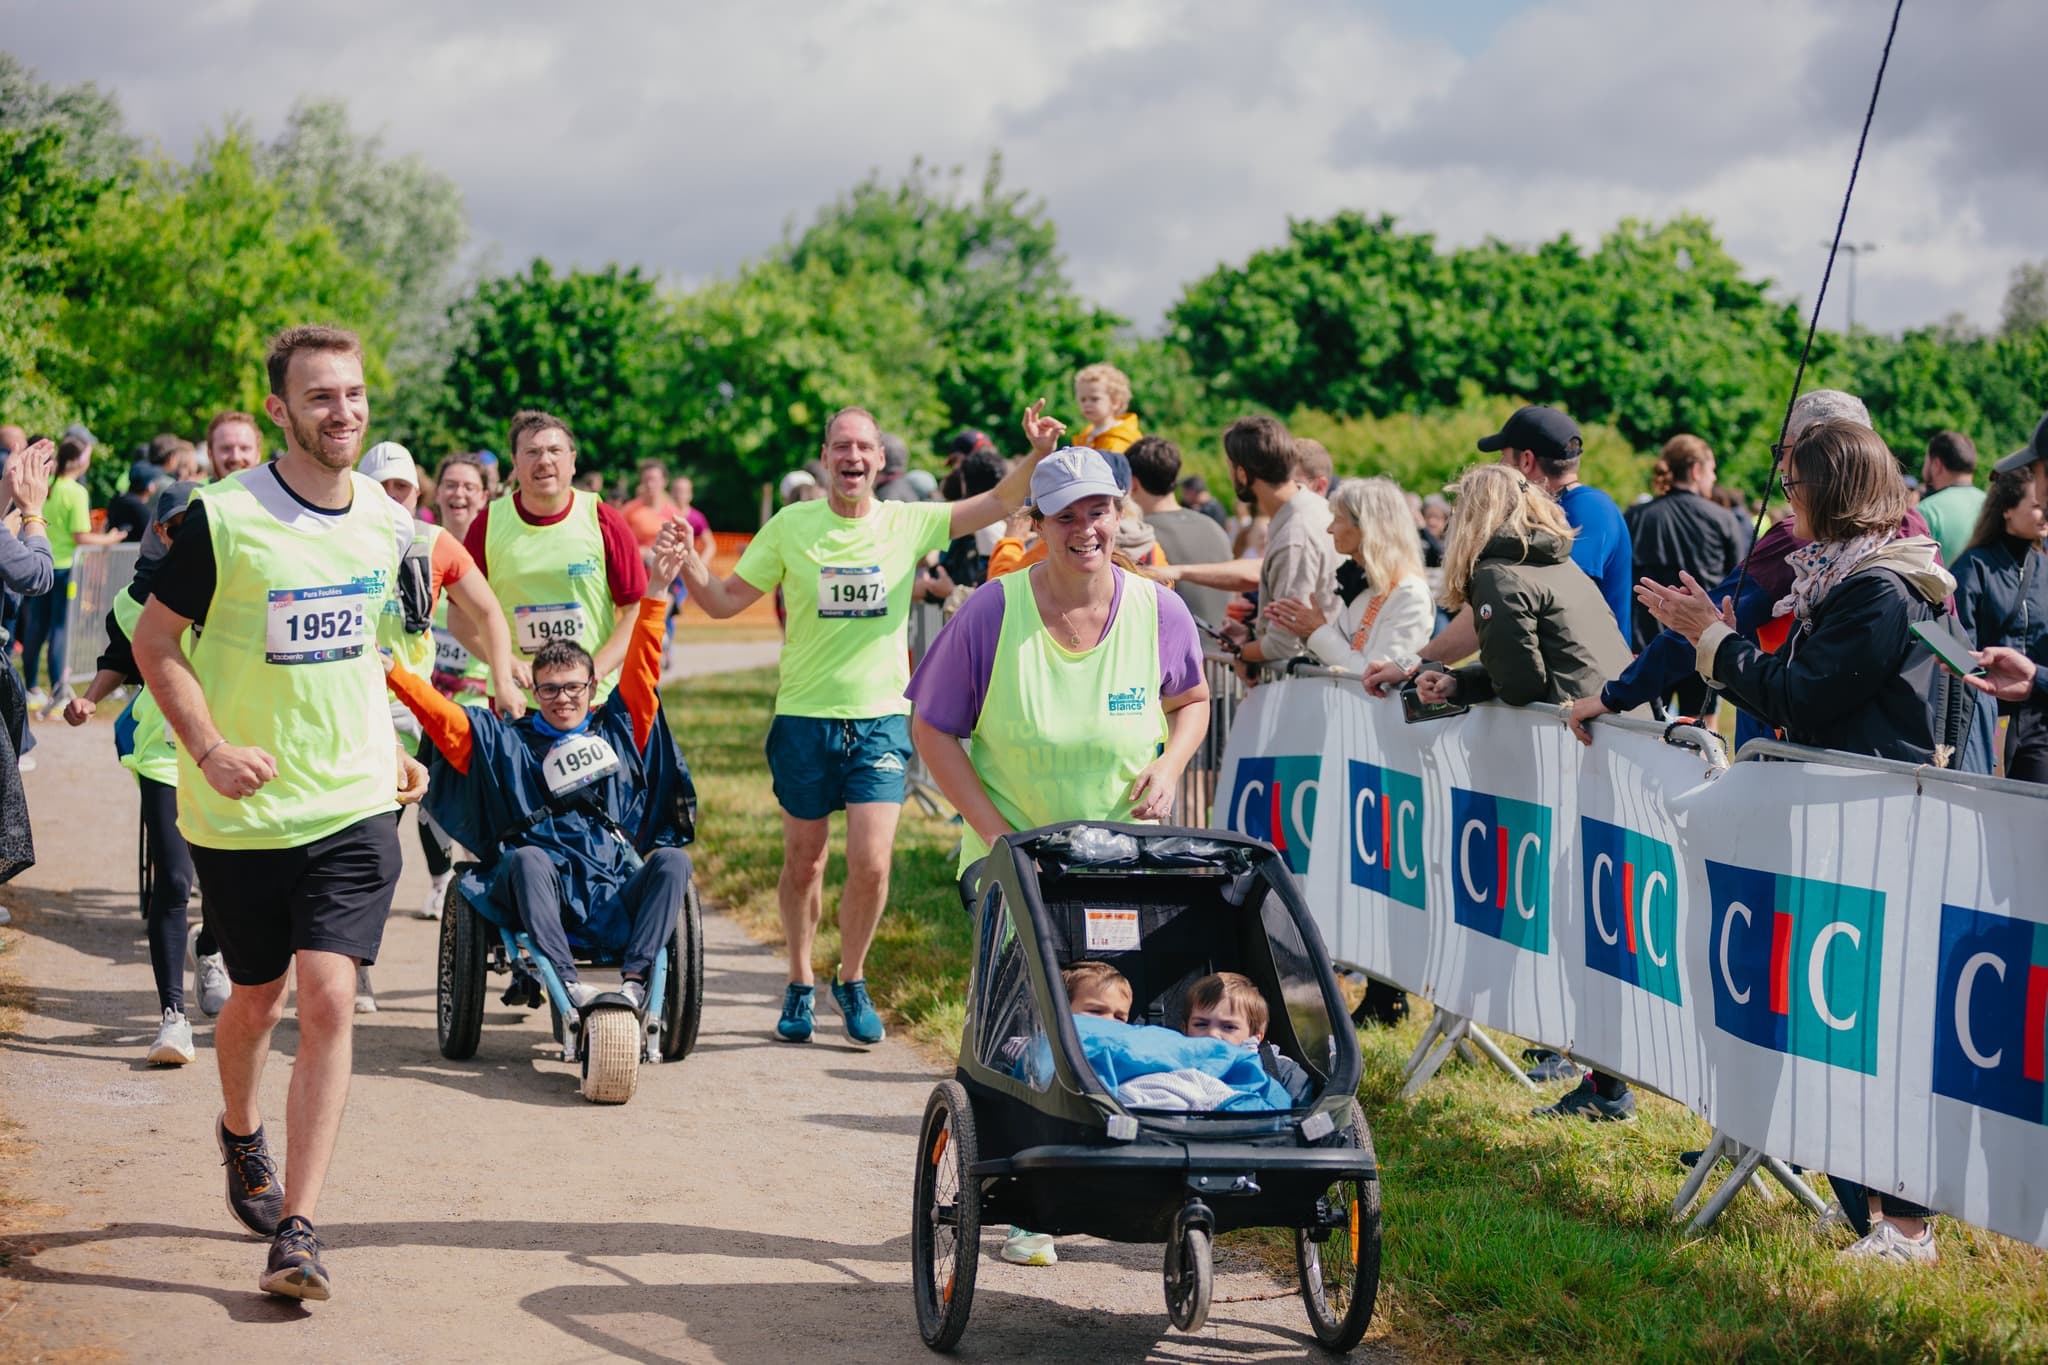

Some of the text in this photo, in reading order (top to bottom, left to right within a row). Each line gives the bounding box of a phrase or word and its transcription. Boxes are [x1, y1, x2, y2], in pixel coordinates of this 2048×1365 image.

[831, 583, 879, 602] 1947
[286, 609, 352, 642] 1952
[527, 619, 576, 639] 1948
[314, 650, 335, 660] CIC
[436, 642, 461, 660] 954
[1108, 701, 1142, 711] Blancs
[553, 743, 604, 776] 1950
[1236, 779, 1320, 850] CIC
[1355, 787, 1418, 880] CIC
[1459, 818, 1542, 919] CIC
[1591, 852, 1668, 968] CIC
[1719, 901, 1862, 1031] CIC
[1954, 951, 2048, 1083] CI
